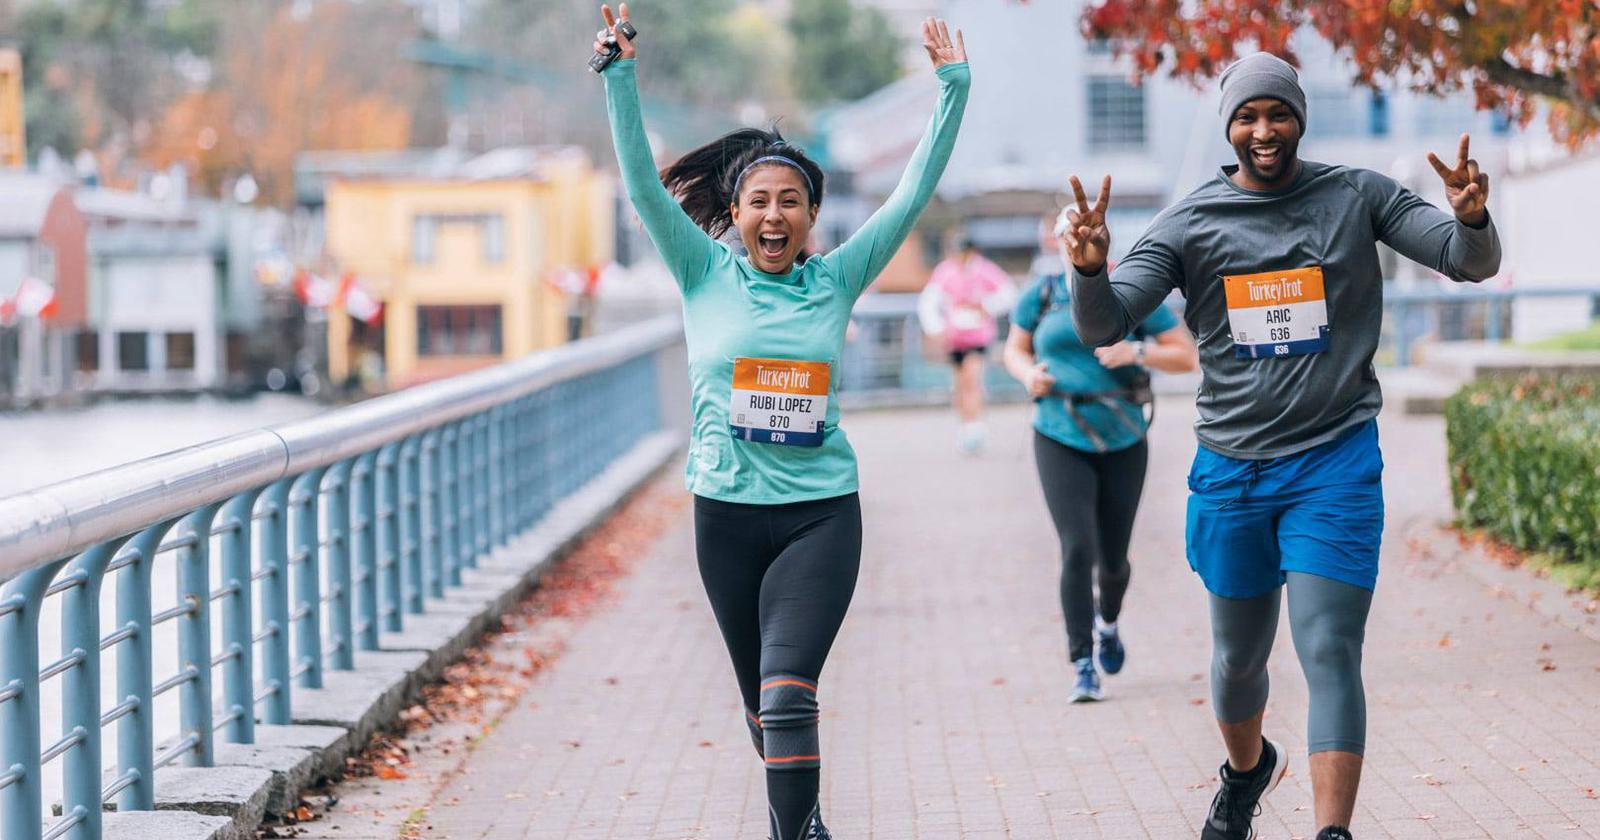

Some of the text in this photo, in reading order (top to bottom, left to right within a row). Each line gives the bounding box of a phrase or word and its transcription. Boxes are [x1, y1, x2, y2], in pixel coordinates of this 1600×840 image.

[1266, 308, 1291, 324] ARIC
[1270, 327, 1290, 341] 636
[1274, 344, 1289, 355] 636
[749, 395, 812, 413] RUBI LOPEZ
[769, 414, 790, 429] 870
[770, 432, 786, 443] 870
